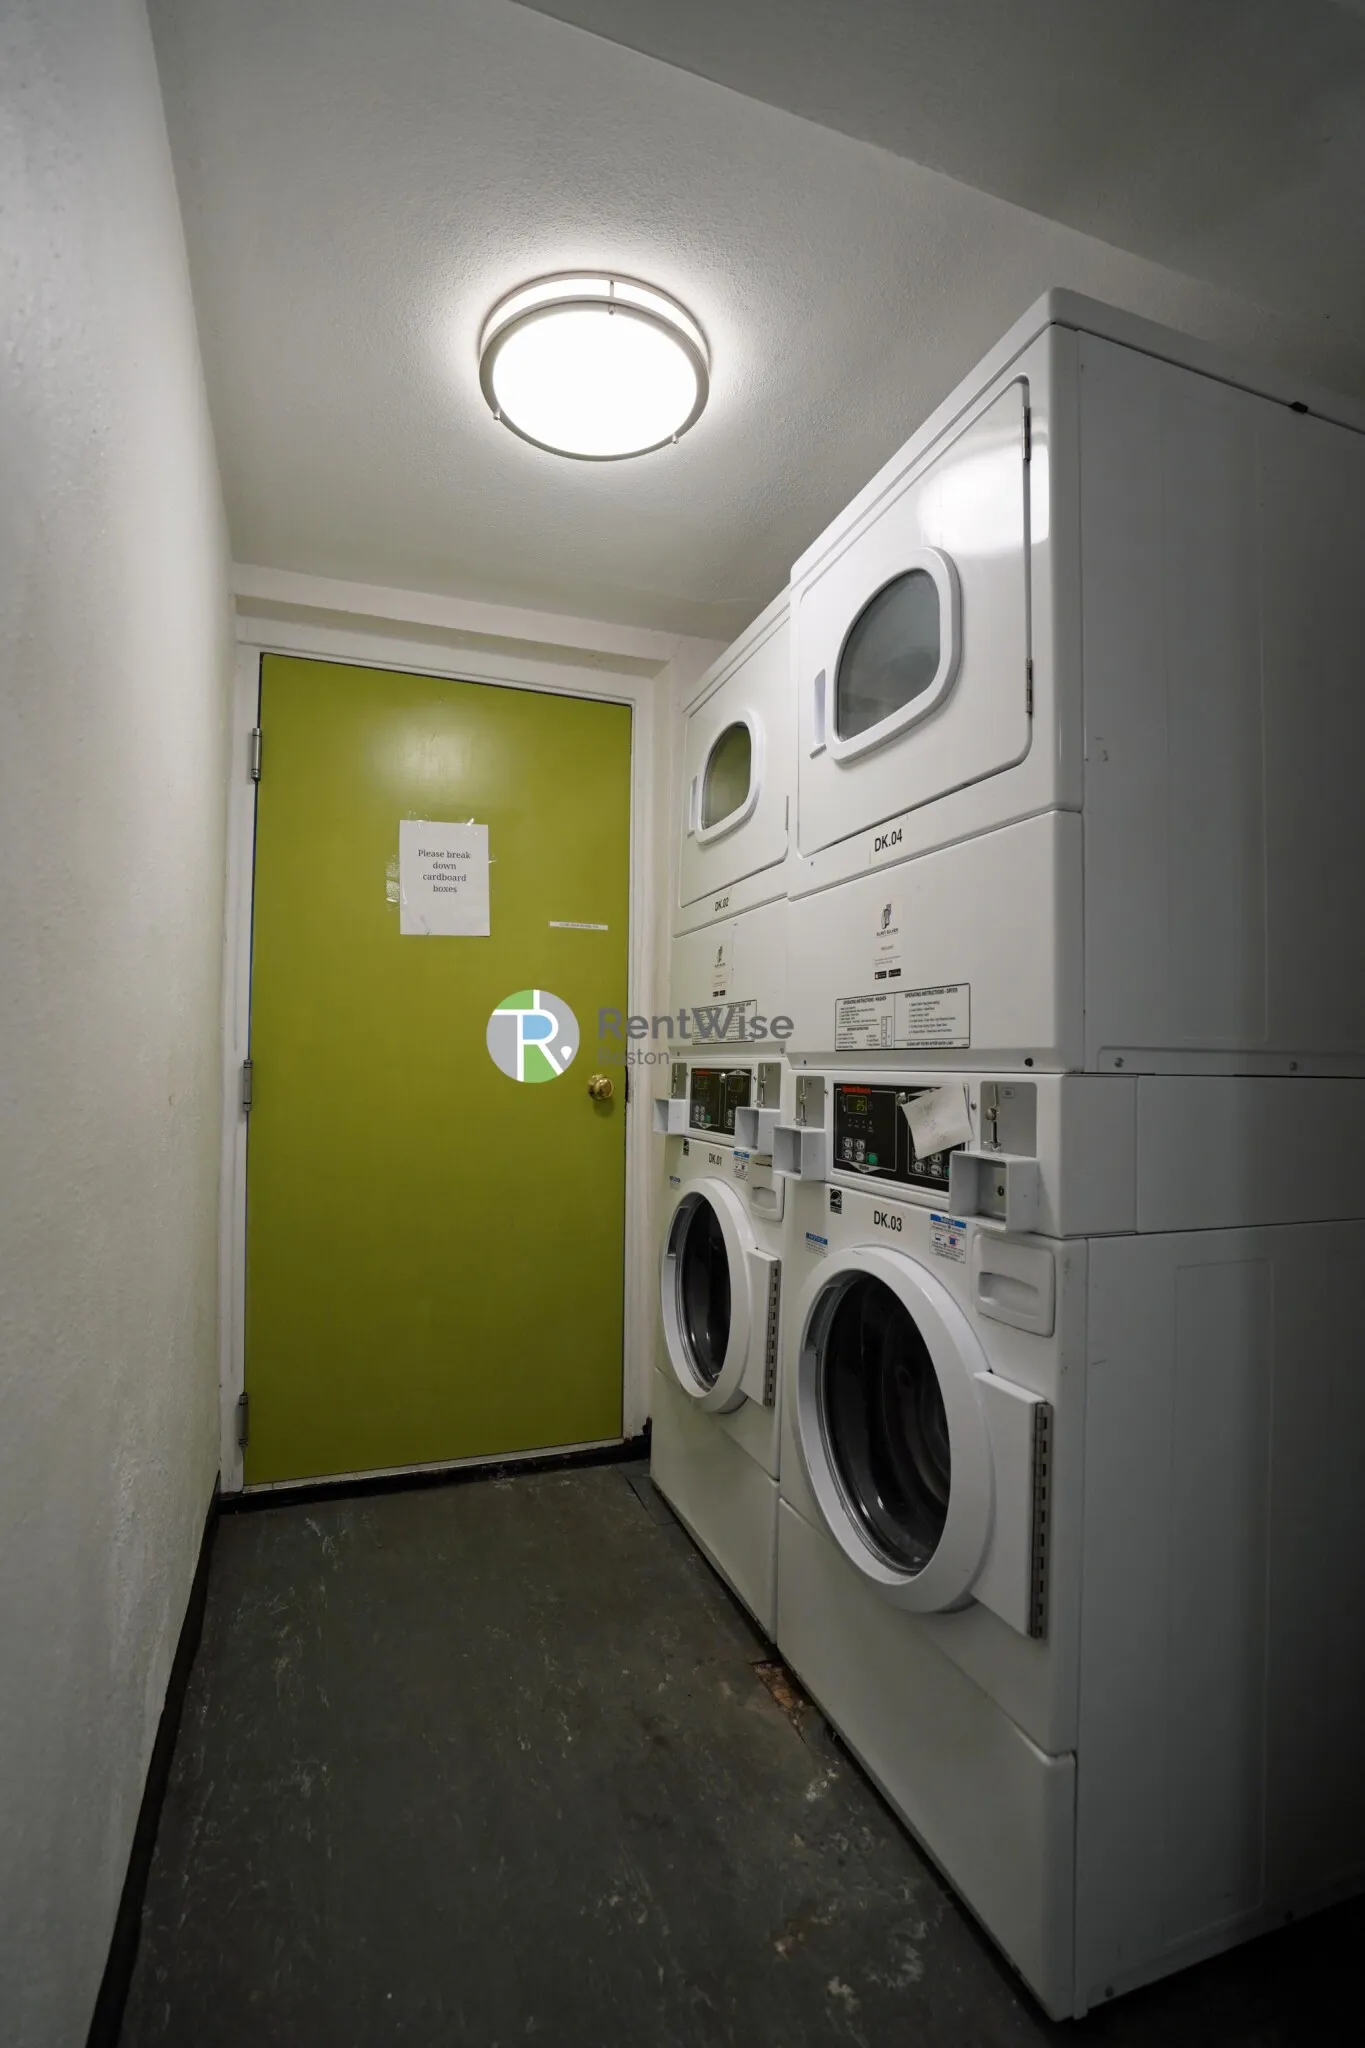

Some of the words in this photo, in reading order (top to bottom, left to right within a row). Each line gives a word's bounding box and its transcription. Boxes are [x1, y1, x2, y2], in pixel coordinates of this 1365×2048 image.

[874, 828, 903, 852] DK.04
[418, 849, 445, 859] Please
[446, 850, 471, 859] break
[432, 861, 457, 870] down
[422, 873, 467, 882] cardboard
[432, 884, 458, 893] boxes
[873, 1209, 903, 1232] DK.03
